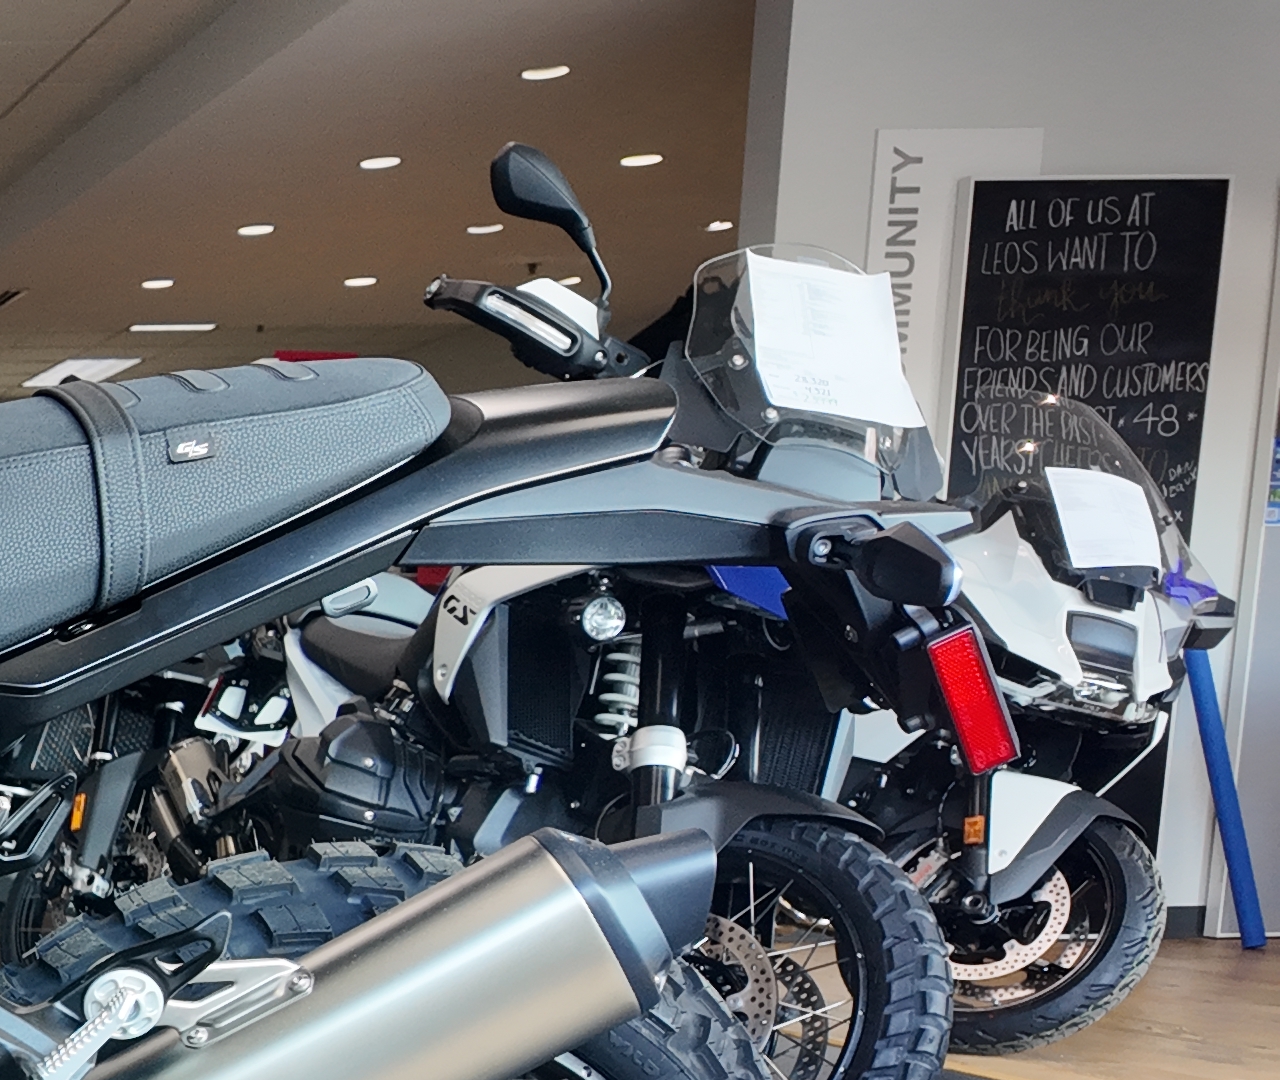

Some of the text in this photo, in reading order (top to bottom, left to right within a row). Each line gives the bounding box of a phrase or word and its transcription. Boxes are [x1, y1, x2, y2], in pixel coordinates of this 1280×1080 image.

[1006, 193, 1156, 232] ALL OF US AT
[981, 231, 1157, 275] LEOS WANT TO
[974, 321, 1154, 364] FOR BEING OUR
[963, 361, 1210, 400] FRIENDS AND CUSTOMERS
[960, 401, 1017, 435] OVER
[1023, 405, 1055, 438] THE
[1132, 402, 1180, 438] 48
